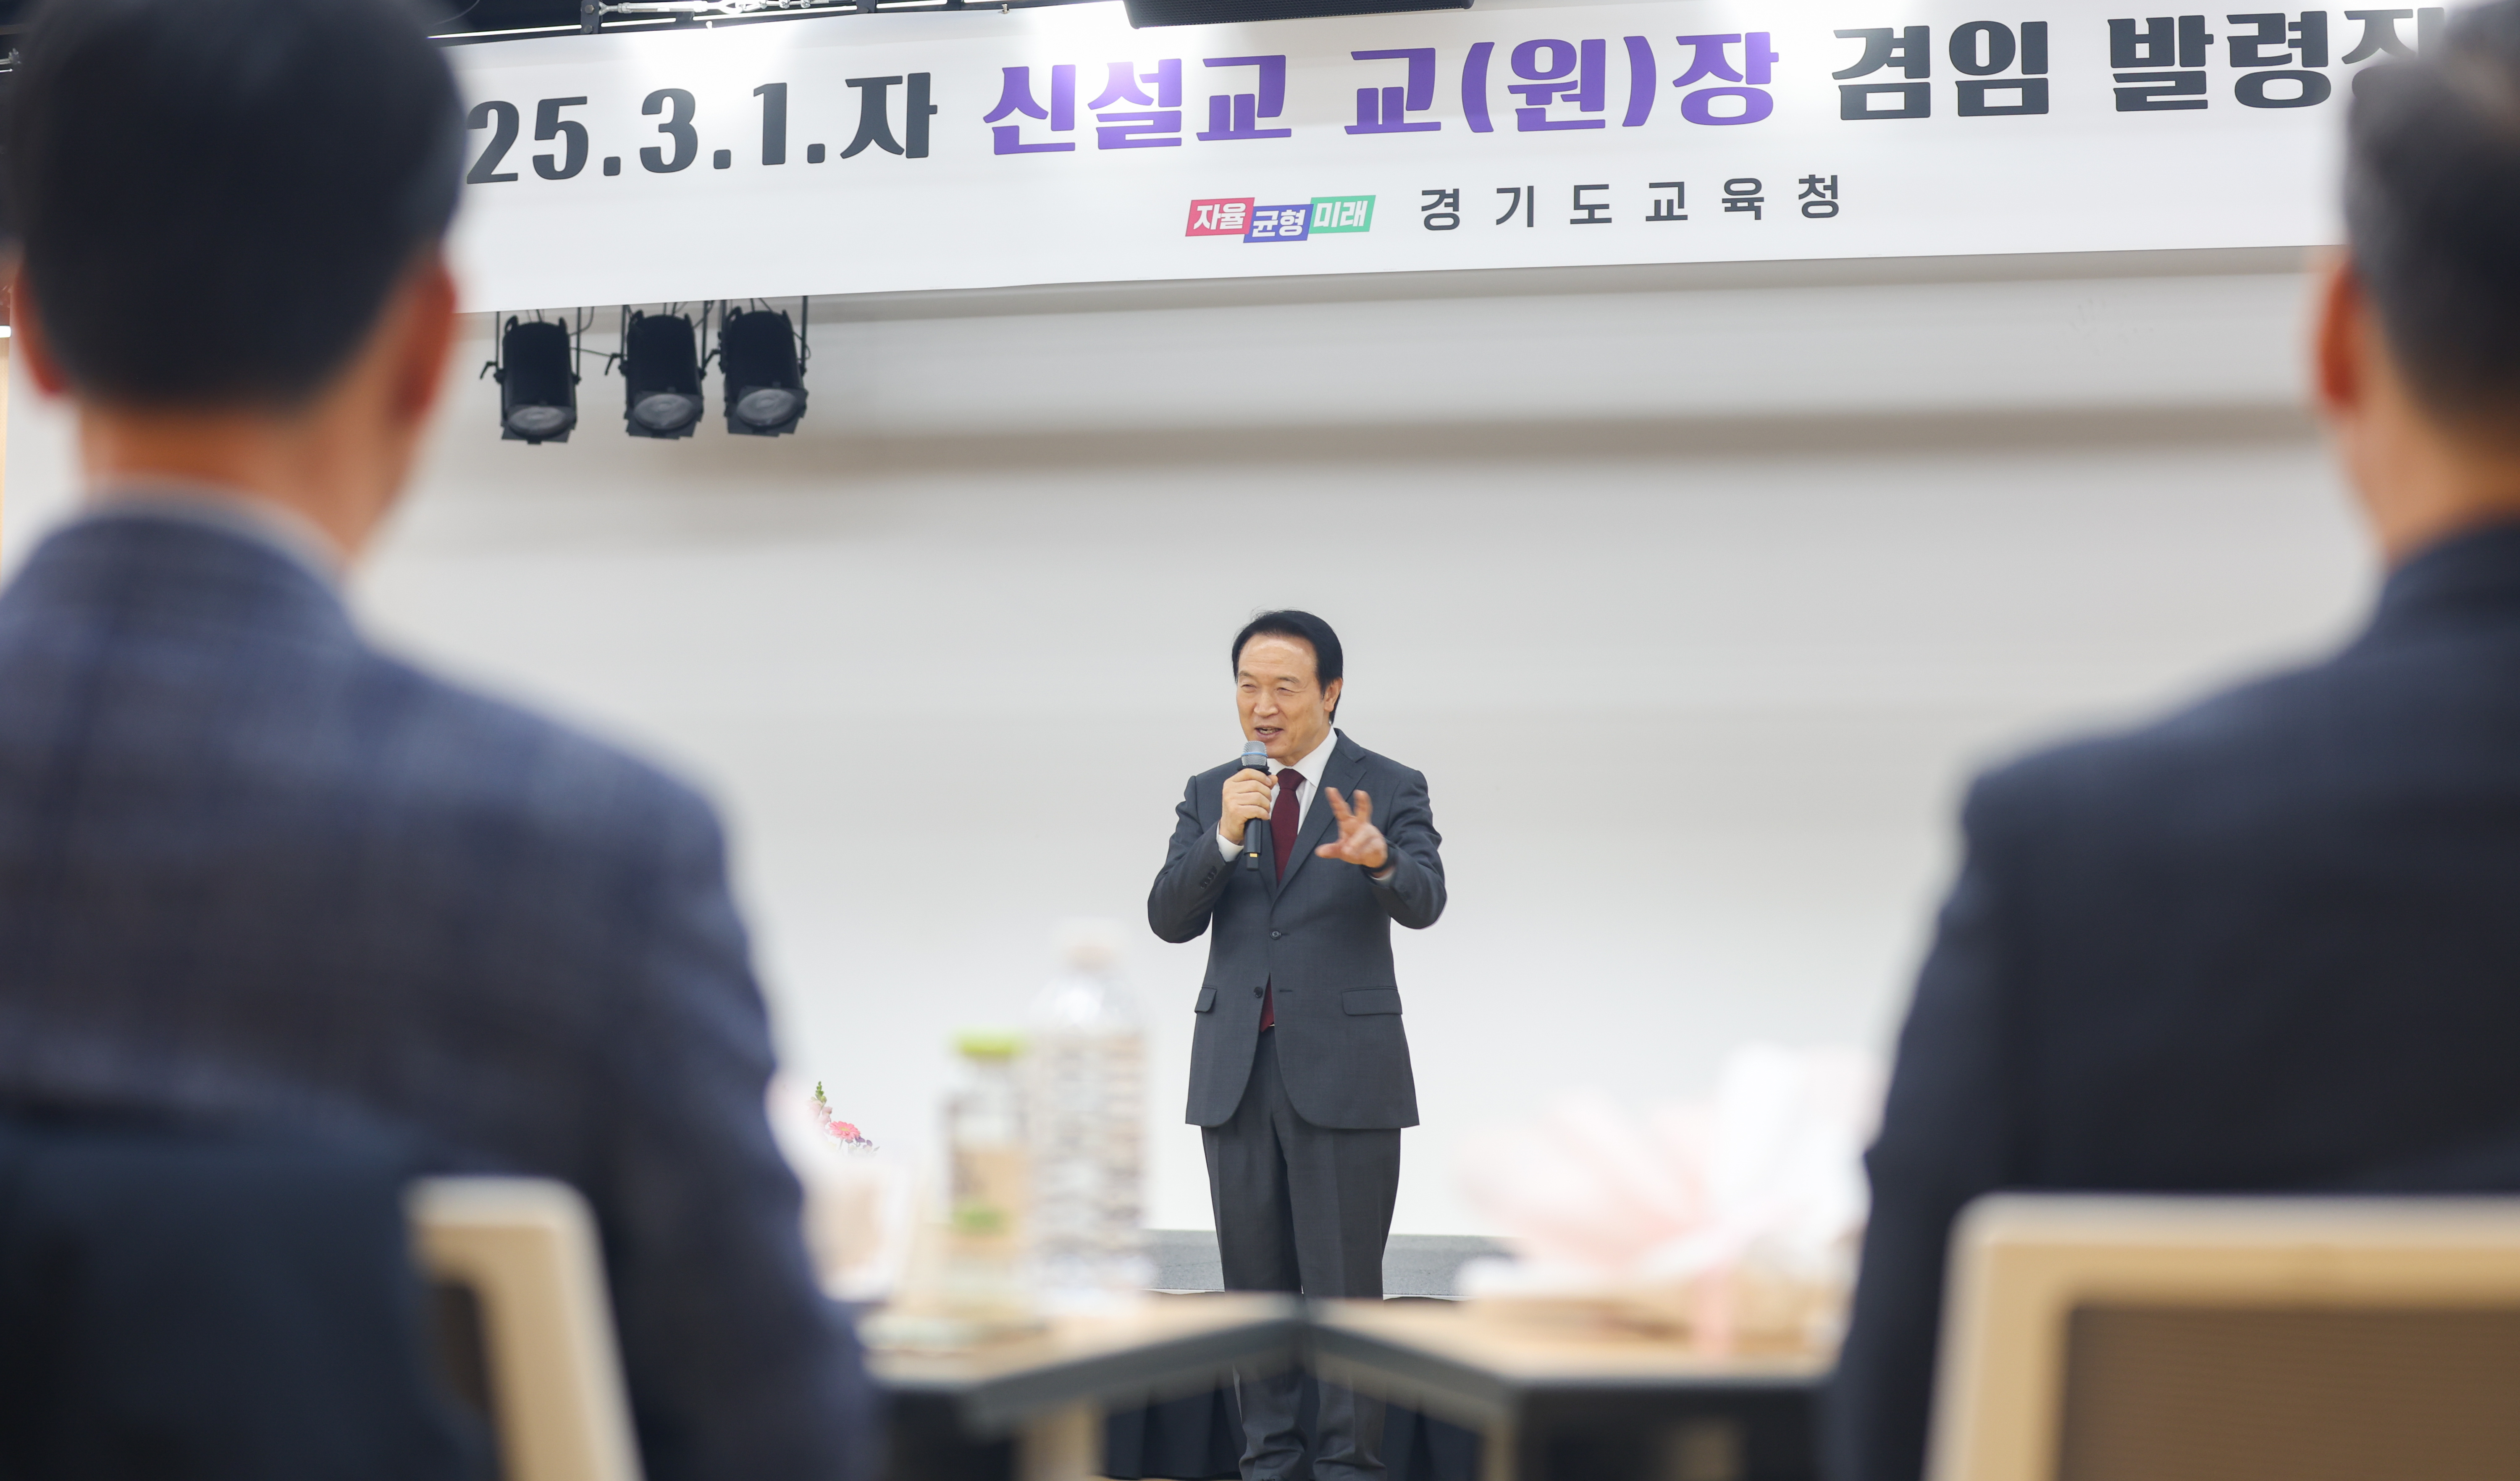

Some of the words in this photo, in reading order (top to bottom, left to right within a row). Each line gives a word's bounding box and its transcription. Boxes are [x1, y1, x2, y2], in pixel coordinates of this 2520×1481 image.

[984, 55, 1292, 155] 신설교
[1344, 31, 1780, 134] 교(원)장
[1831, 20, 2050, 121] 겸임
[1193, 203, 1246, 230] 자율
[1252, 209, 1305, 237] 균형
[1313, 200, 1368, 228] 미래
